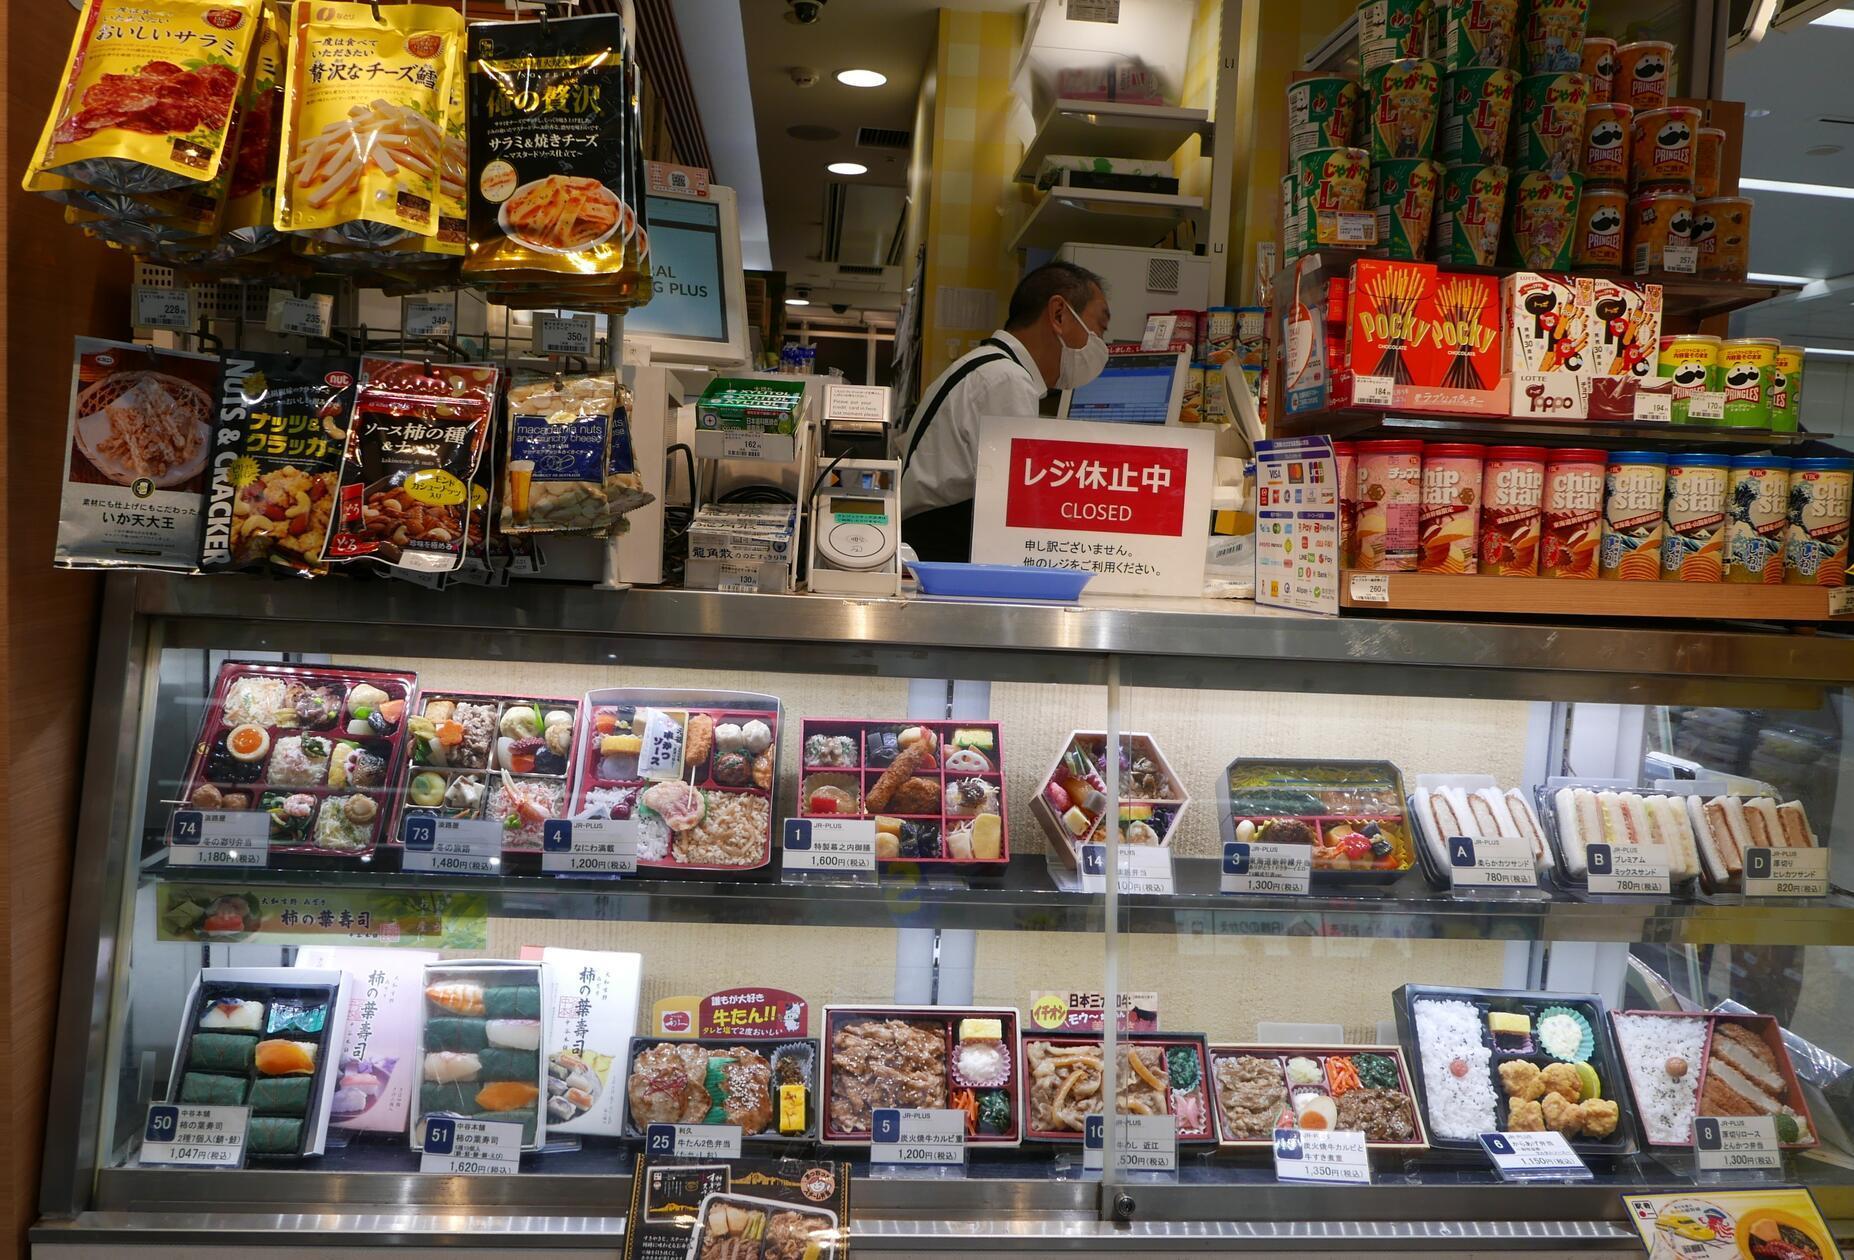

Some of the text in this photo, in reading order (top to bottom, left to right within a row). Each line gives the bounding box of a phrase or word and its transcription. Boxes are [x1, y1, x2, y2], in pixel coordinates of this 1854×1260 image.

[96, 25, 236, 57] おいしいサラミ
[312, 38, 379, 47] 一度は食べて
[312, 50, 374, 58] いただきたい
[1631, 80, 1665, 97] PRINGLES
[1475, 100, 1496, 129] L
[489, 134, 599, 150] サラミ&焼きチーズ
[1588, 147, 1622, 164] PRINGLES
[1655, 147, 1690, 164] PRINGLES
[1317, 180, 1339, 210] L
[1463, 196, 1486, 226] L
[1588, 233, 1620, 250] PRINGLES
[670, 284, 708, 298] PLUS
[1378, 343, 1408, 351] CHOCOLATE
[219, 358, 255, 421] NUTS
[1725, 386, 1759, 402] PRINGLES
[725, 399, 779, 407] XYLITOL
[250, 412, 320, 433] ナッツ&
[365, 422, 467, 446] ソース柿の種
[580, 426, 602, 434] nuts
[217, 428, 241, 447] &
[1025, 458, 1171, 493] レジ休止中
[1269, 469, 1281, 479] VISA
[202, 451, 239, 566] CRACKER
[1061, 502, 1132, 521] CLOSED
[102, 512, 175, 530] いか天大王
[1025, 539, 1134, 558] 申し訳ございません。
[1023, 557, 1162, 576] 他のレジをご利用ください。
[650, 737, 663, 766] ソース
[180, 822, 196, 835] 74
[573, 822, 603, 830] JR-PLUS
[412, 827, 429, 841] 73
[552, 830, 562, 843] 4
[795, 828, 801, 841] 1
[574, 843, 615, 853] なにわ満載
[814, 843, 871, 852] 特製幕之内御膳
[1457, 846, 1467, 858] A
[431, 857, 493, 870] 1,480円(税込)
[570, 857, 631, 870] 1,200円(税込)
[811, 856, 869, 867] 1,600円(税込)
[1088, 855, 1103, 867] 14
[1232, 852, 1240, 865] 3
[1478, 859, 1530, 867] 柔らかカツサンド
[1594, 854, 1604, 865] B
[1615, 856, 1646, 864] プレミアム
[1755, 857, 1764, 869] D
[1773, 859, 1793, 867] 厚切り
[1485, 872, 1531, 883] 780円(税込)
[1615, 868, 1656, 876] ミックスサンド
[1773, 870, 1816, 878] ヒレカツサンド
[1248, 880, 1303, 892] 1,300円(税込)
[1617, 881, 1662, 892] 780円(税込)
[1777, 883, 1822, 893] 820円(税込)
[711, 993, 765, 1006] 誰もが大好き
[712, 1006, 777, 1027] 牛たん!!
[703, 1026, 783, 1037] タレと塩で2度おいしい
[153, 1116, 172, 1129] 50
[179, 1121, 223, 1131] 柿の葉寿司
[882, 1120, 890, 1132] 5
[431, 1128, 447, 1142] 51
[901, 1134, 963, 1143] 炭火焼牛カルビ重
[1704, 1127, 1713, 1139] 8
[1722, 1130, 1761, 1138] 厚切りロース
[456, 1135, 499, 1145] 柿の葉寿司
[652, 1135, 669, 1149] 25
[677, 1139, 731, 1148] 牛たん2色弁当
[1143, 1140, 1159, 1149] 近江
[1494, 1140, 1504, 1149] 6
[1723, 1141, 1764, 1150] とんかつ弁当
[1304, 1142, 1364, 1152] 炭火焼牛カルビと
[170, 1148, 231, 1160] 1,047円(税込)
[899, 1148, 957, 1161] 1,200円(税込)
[1724, 1154, 1776, 1165] 1,300円(税込)
[450, 1161, 512, 1174] 1,620円(税込)
[1304, 1166, 1364, 1178] 1,350円(税込)
